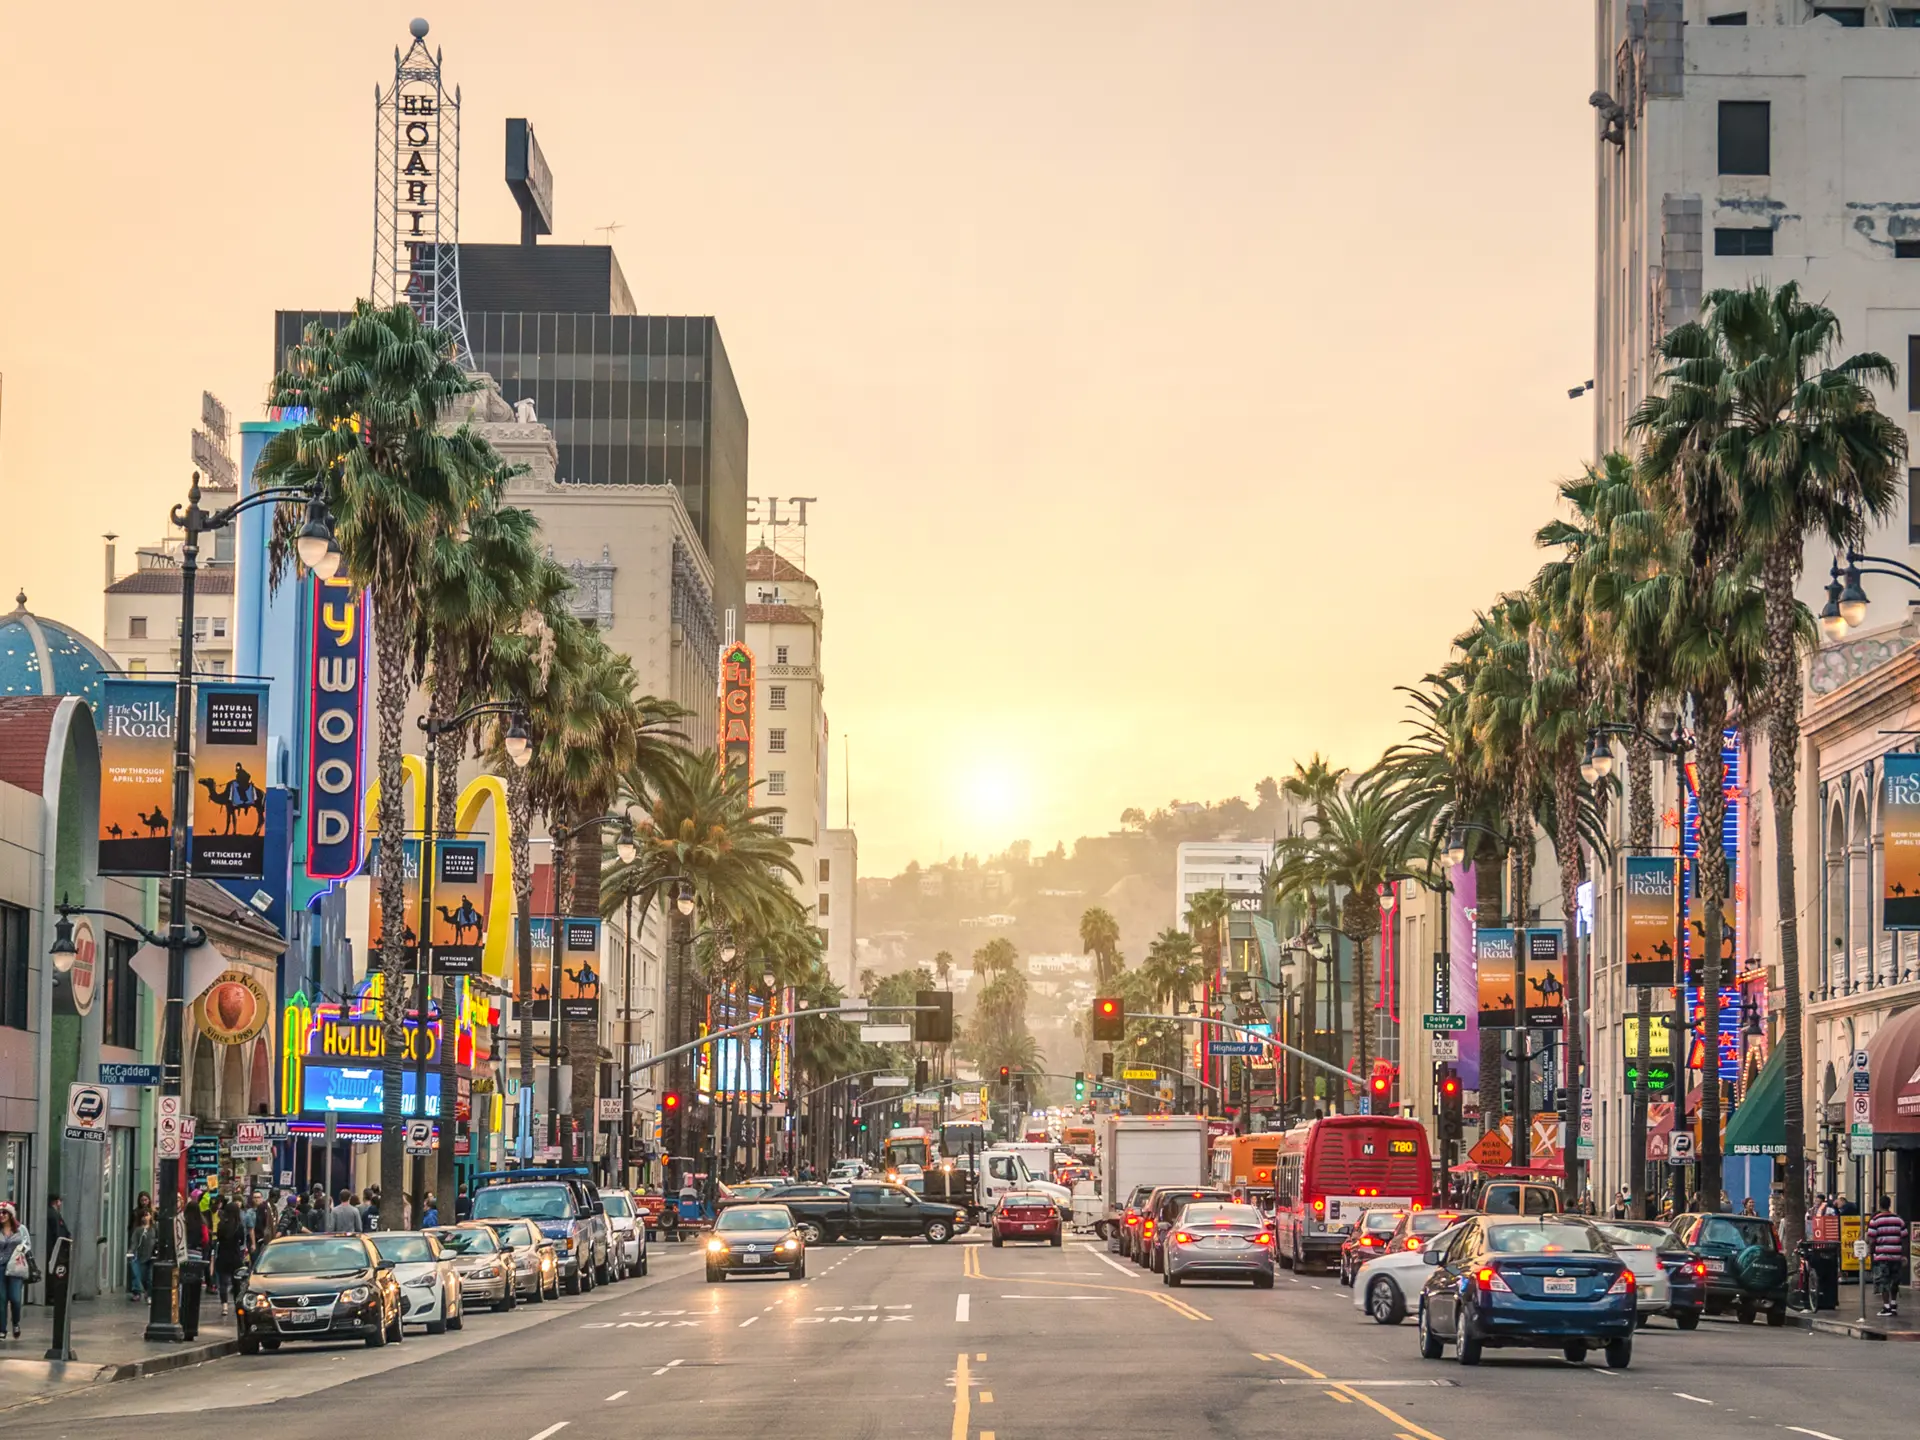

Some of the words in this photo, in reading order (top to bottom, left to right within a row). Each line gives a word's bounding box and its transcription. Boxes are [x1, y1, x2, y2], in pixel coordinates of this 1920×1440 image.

[115, 704, 130, 714] The
[131, 701, 166, 722] Silk
[115, 715, 171, 738] Road
[1894, 775, 1909, 784] The
[1644, 870, 1668, 885] Silk
[1634, 880, 1672, 896] Road
[1492, 940, 1510, 950] Silk
[1484, 947, 1513, 958] Road
[205, 1026, 230, 1043] Since
[232, 1029, 254, 1043] 1989
[1213, 1044, 1246, 1053] Highland
[102, 1066, 150, 1076] McCadden
[1632, 1081, 1664, 1089] TATRE
[67, 1129, 81, 1138] PAY
[84, 1131, 104, 1141] HERE
[240, 1126, 264, 1137] ATM
[1394, 1141, 1412, 1152] 780
[1734, 1145, 1760, 1154] CAMERAS
[371, 1218, 377, 1229] 5
